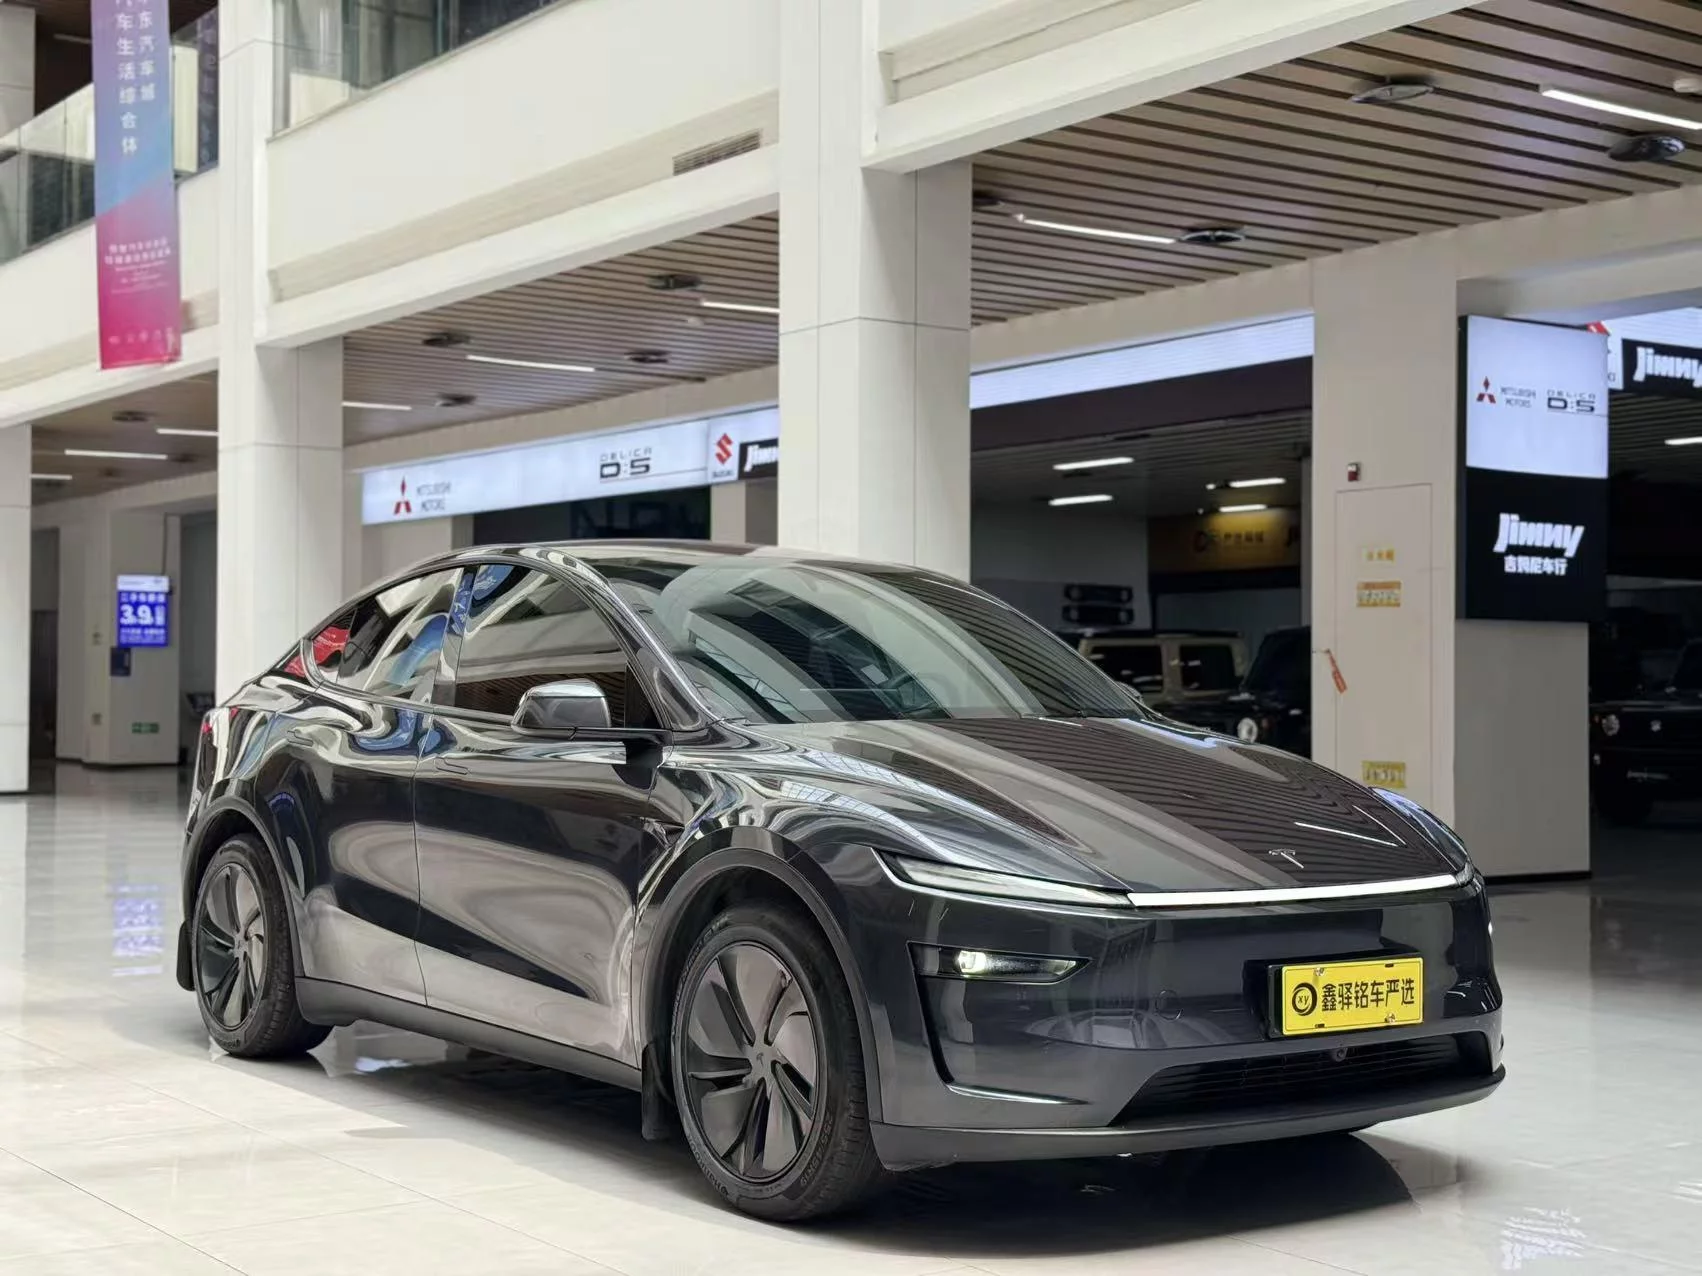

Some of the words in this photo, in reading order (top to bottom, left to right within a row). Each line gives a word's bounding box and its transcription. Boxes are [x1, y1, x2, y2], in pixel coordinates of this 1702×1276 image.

[1492, 512, 1585, 558] Jimny
[1321, 977, 1415, 1012] 鑫驿铭车严选
